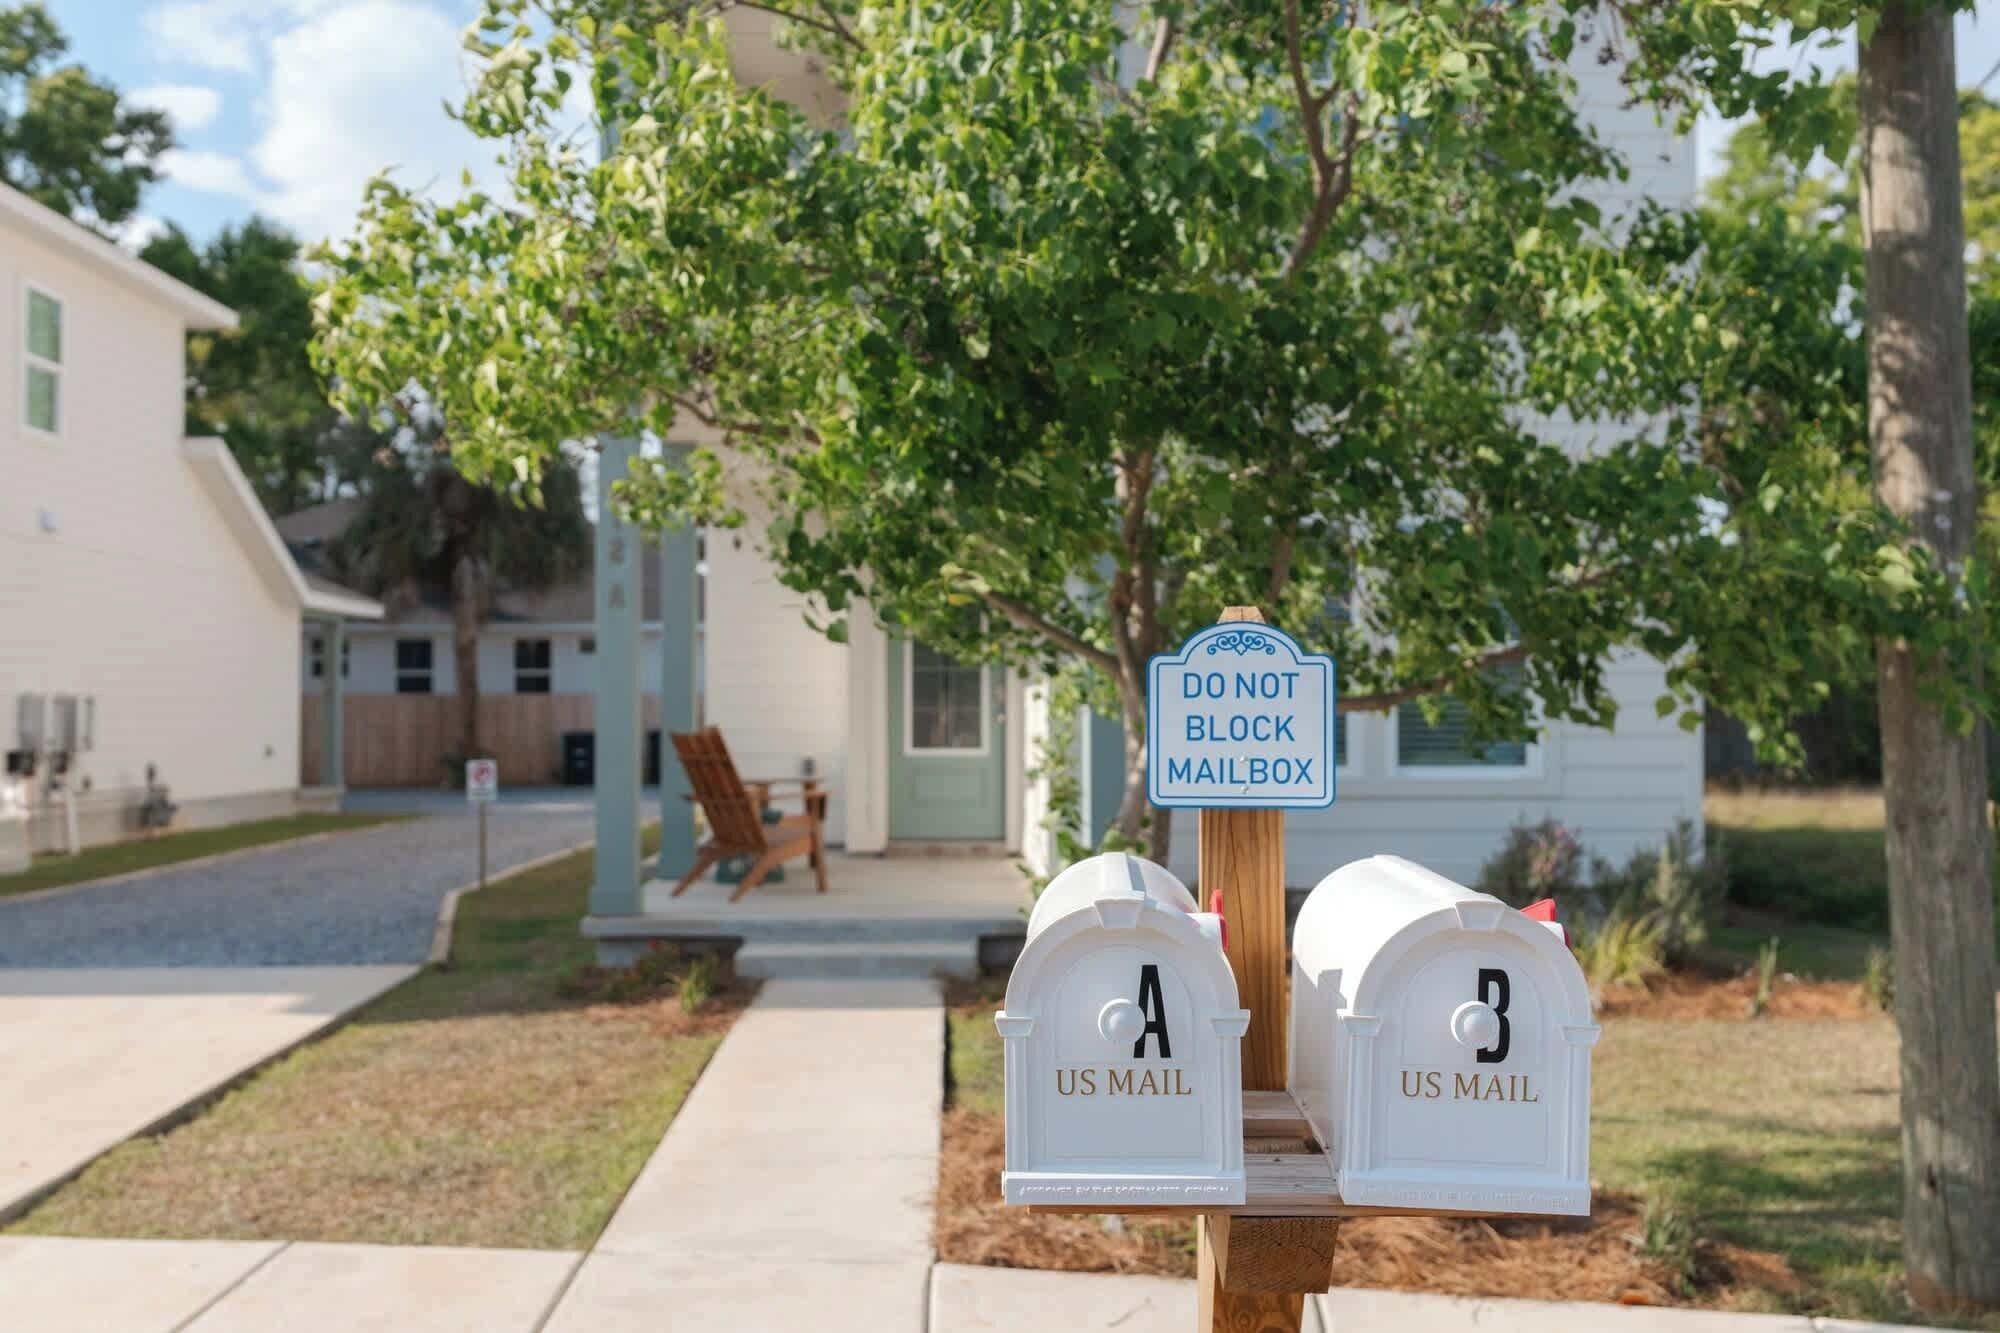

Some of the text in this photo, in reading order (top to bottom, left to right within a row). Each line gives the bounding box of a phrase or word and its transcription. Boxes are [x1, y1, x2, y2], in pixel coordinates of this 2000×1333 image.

[1183, 672, 1300, 699] DO NOT
[1186, 715, 1295, 742] BLOCK
[1168, 757, 1313, 785] MAILBOX
[1133, 964, 1172, 1059] A
[1476, 967, 1511, 1064] B
[1056, 1068, 1193, 1097] US MAIL
[1400, 1070, 1539, 1104] US MAIL
